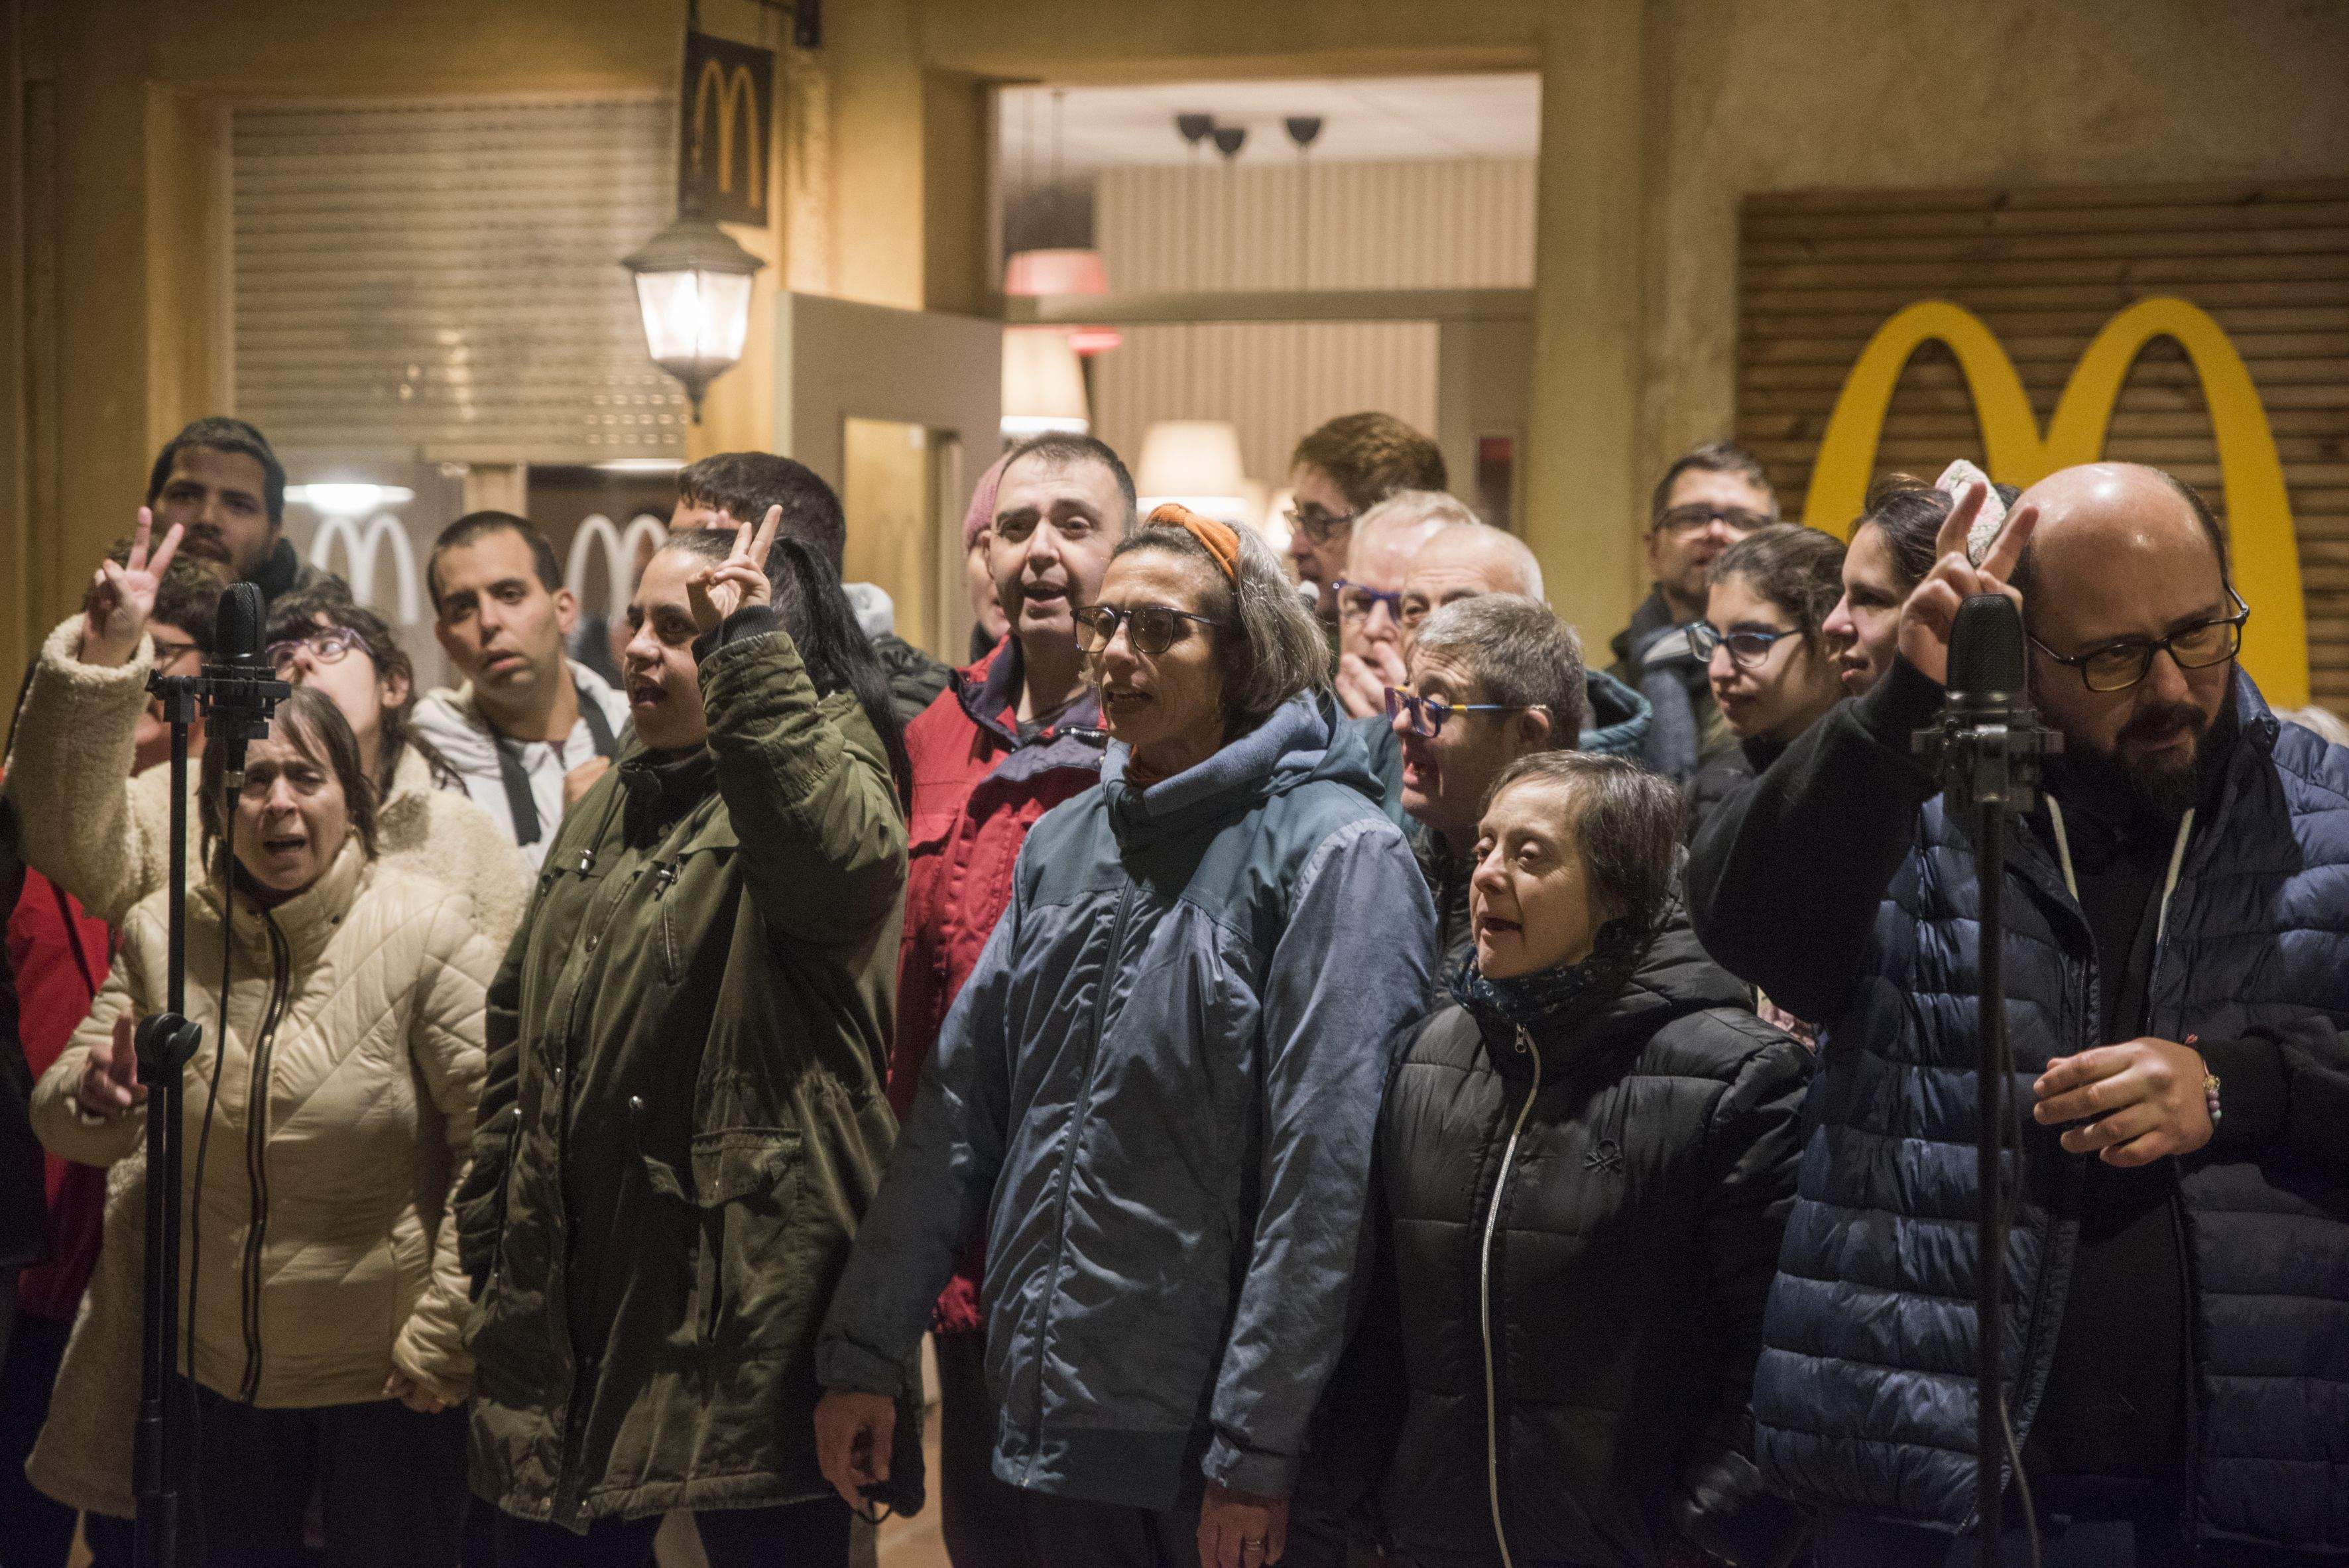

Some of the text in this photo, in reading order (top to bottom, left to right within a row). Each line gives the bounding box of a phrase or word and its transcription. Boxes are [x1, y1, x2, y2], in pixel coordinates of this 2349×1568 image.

[693, 58, 760, 208] M
[310, 513, 417, 625] M
[1802, 298, 2309, 707] M
